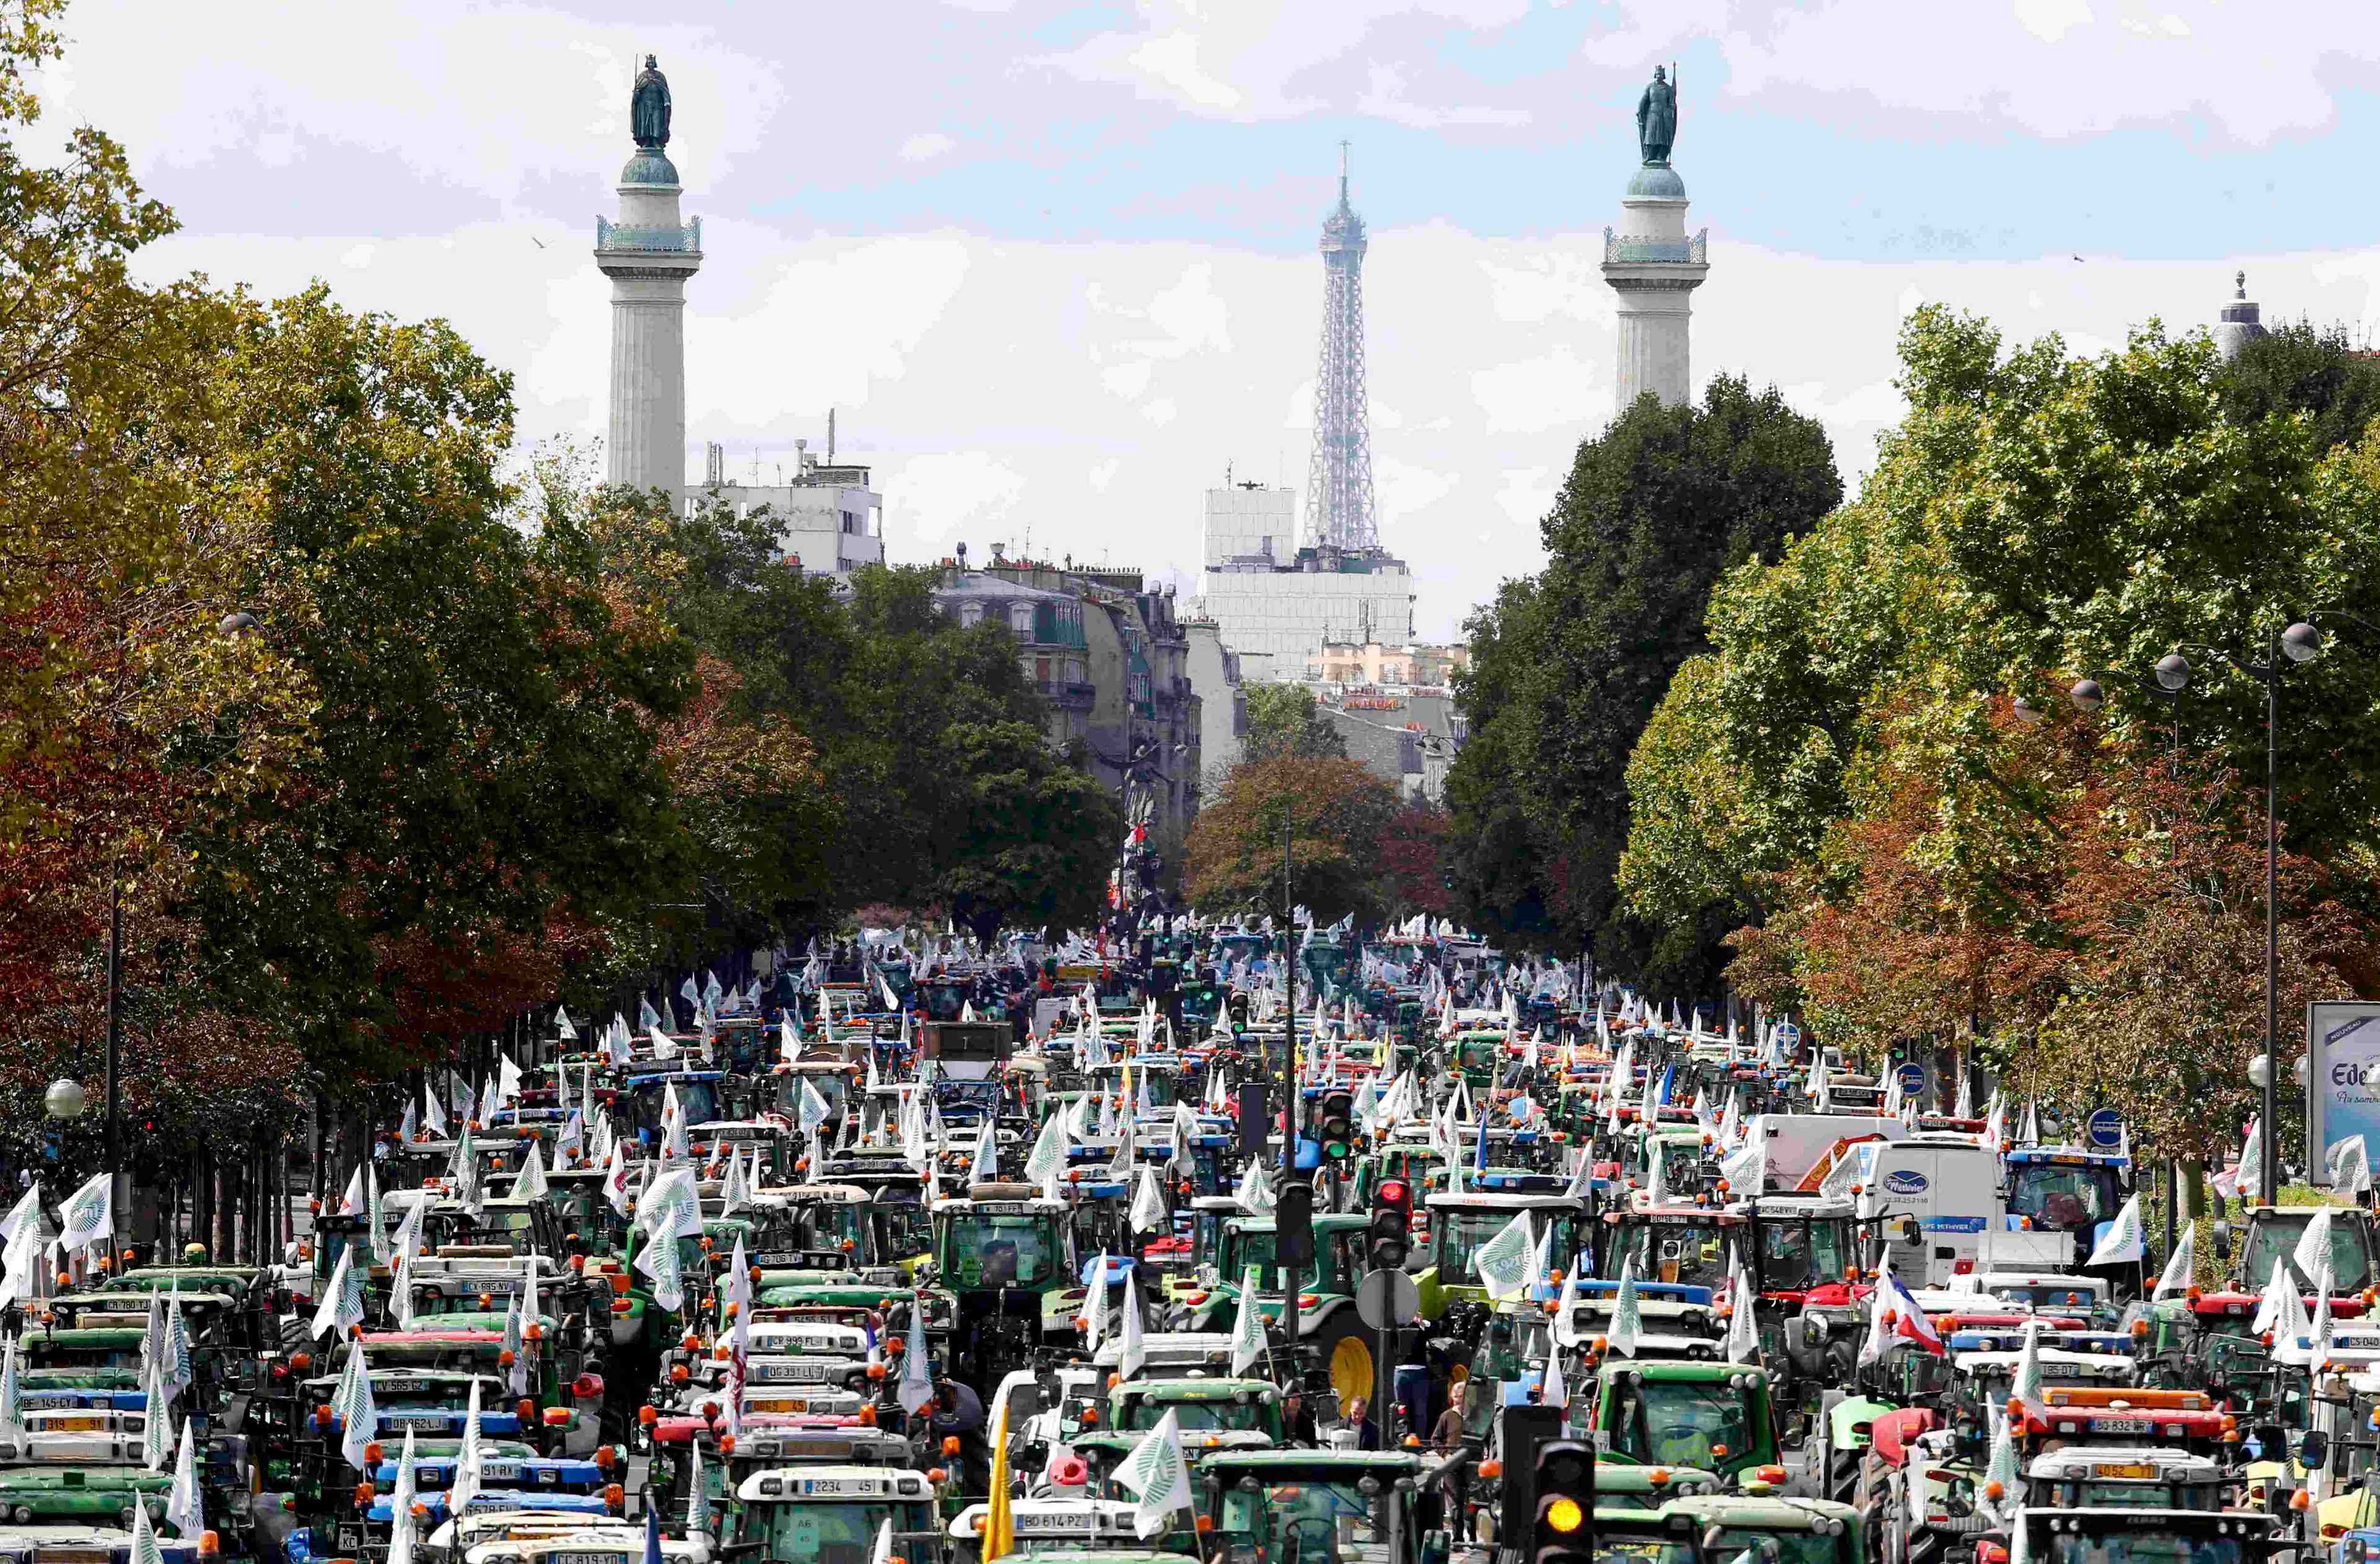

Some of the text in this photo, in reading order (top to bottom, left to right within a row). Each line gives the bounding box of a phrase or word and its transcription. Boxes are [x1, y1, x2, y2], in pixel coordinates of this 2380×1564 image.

[2330, 1020, 2361, 1040] NOUVEAU
[2332, 1063, 2373, 1086] Ede
[343, 1537, 355, 1548] KC
